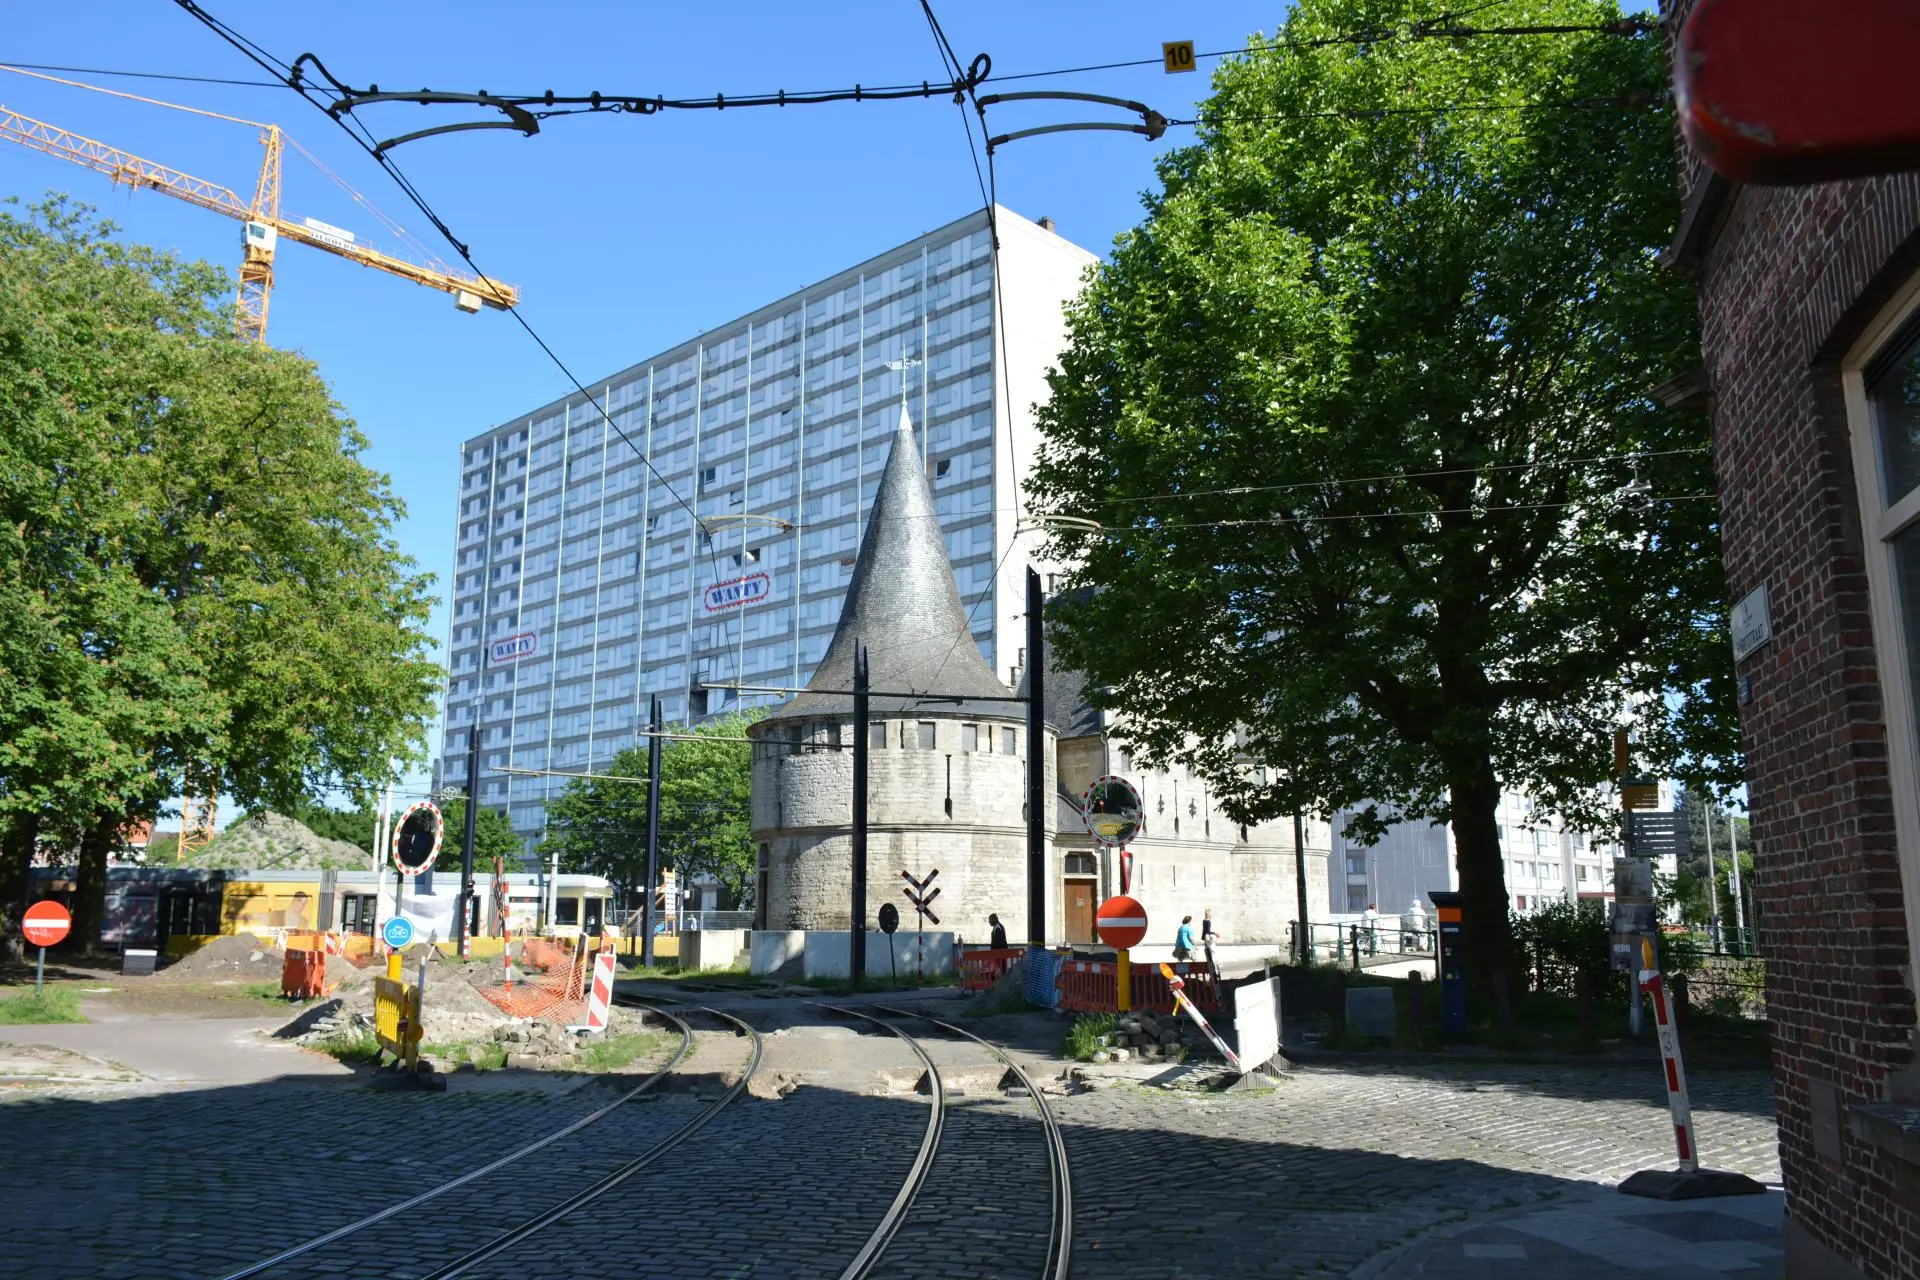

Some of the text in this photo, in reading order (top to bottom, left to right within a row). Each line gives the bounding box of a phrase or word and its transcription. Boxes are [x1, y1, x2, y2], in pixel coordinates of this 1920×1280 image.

[1166, 45, 1191, 66] 10
[711, 580, 763, 604] WANTY
[496, 638, 531, 656] WANTY
